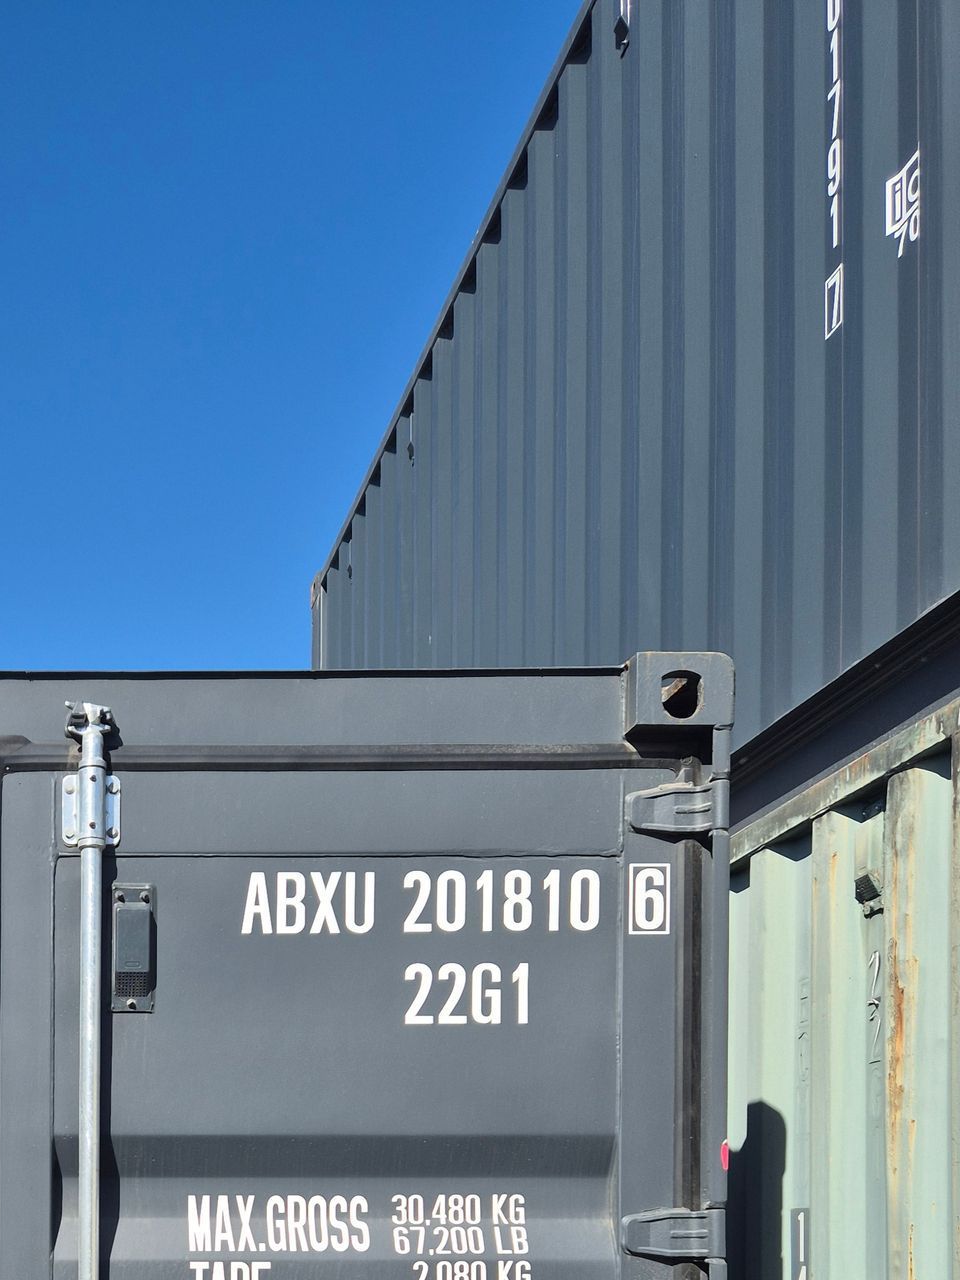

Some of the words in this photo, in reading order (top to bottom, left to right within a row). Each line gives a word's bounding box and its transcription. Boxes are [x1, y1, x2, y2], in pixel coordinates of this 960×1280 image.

[826, 268, 841, 332] 7
[241, 871, 375, 934] ABXU
[403, 869, 600, 933] 201810
[632, 867, 666, 931] 6
[404, 962, 530, 1025] 22G1
[187, 1194, 371, 1253] MAX.GROSS
[391, 1194, 481, 1227] 30,480
[492, 1193, 526, 1225] KG
[392, 1226, 485, 1256] 67,200
[494, 1226, 529, 1255] LB
